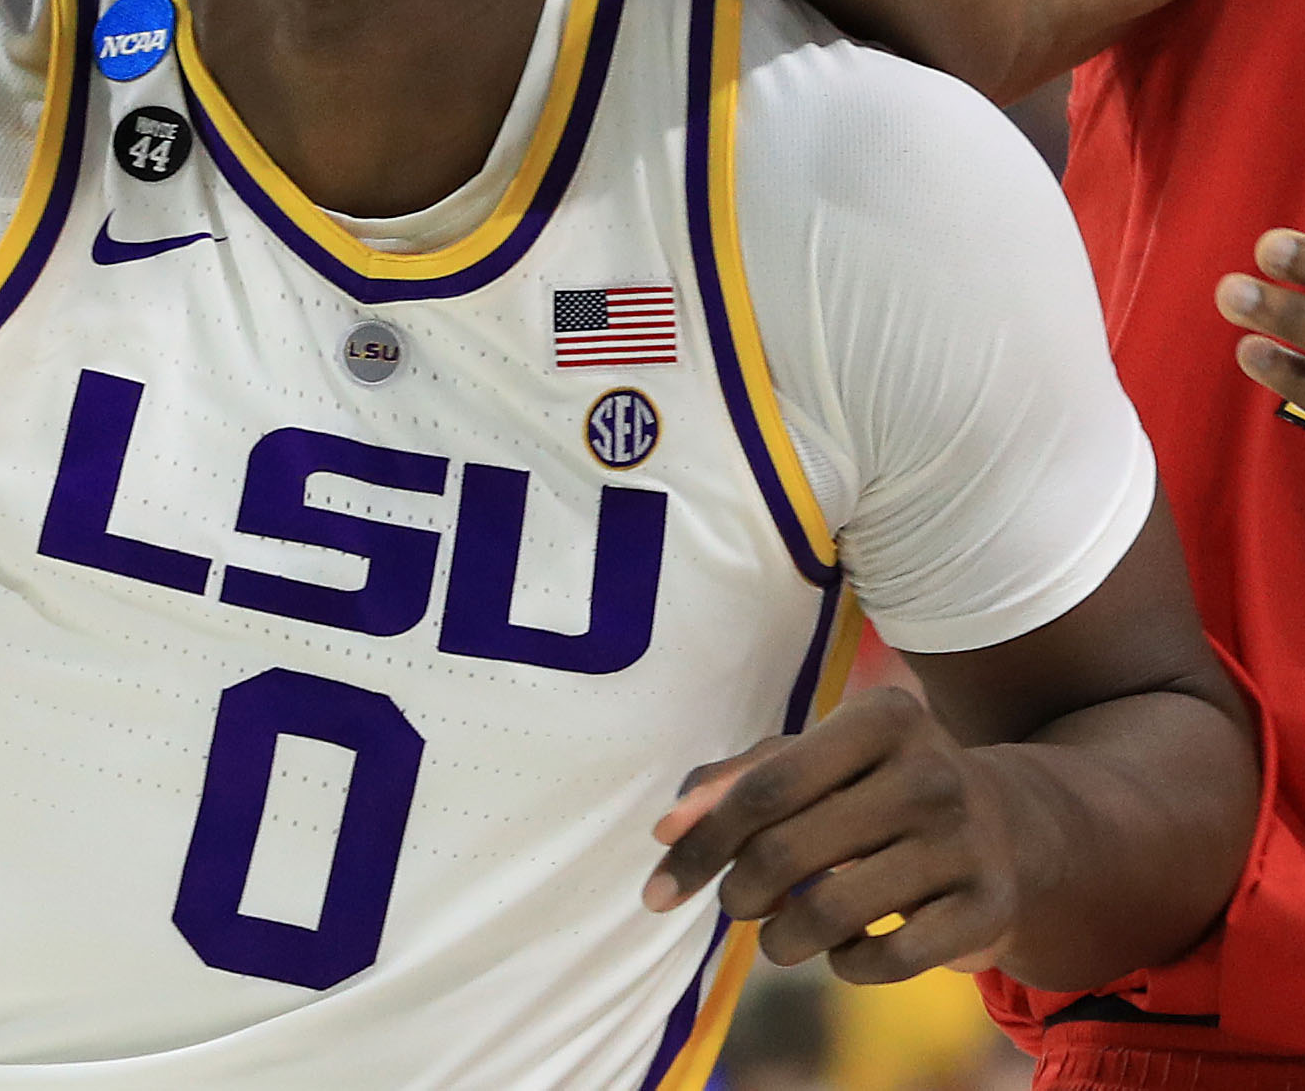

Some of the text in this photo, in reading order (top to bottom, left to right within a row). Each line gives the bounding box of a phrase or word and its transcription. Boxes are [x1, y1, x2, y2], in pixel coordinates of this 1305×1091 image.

[100, 29, 168, 59] NCAA
[129, 136, 173, 172] 44
[348, 341, 400, 362] LSU
[590, 394, 655, 462] SEC
[38, 369, 668, 675] LSU
[172, 667, 426, 991] 0
